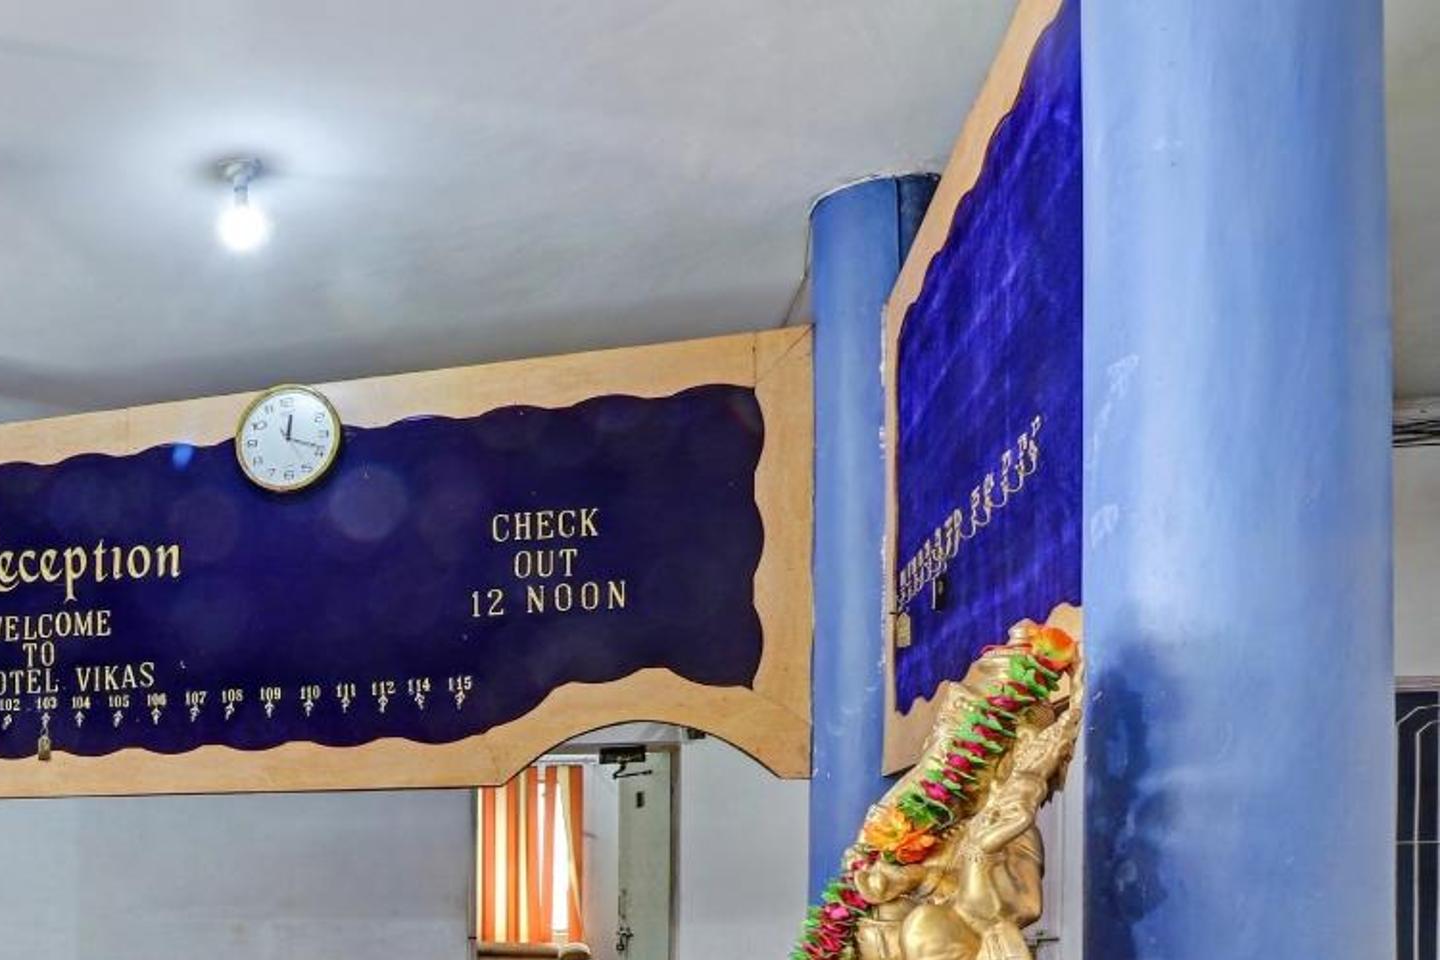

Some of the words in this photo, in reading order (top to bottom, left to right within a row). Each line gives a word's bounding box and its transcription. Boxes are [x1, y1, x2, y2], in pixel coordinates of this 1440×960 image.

[314, 413, 325, 423] 2
[491, 507, 599, 542] CHECK
[513, 547, 578, 579] OUT
[471, 588, 505, 618] 12
[526, 579, 627, 614] NOON
[22, 641, 56, 668] TO
[75, 661, 156, 693] VIKAS
[0, 698, 21, 712] 102
[72, 695, 91, 710] 104
[109, 694, 131, 708] 105
[185, 691, 207, 705] 107
[222, 688, 244, 703] 108
[260, 686, 282, 701] 109
[300, 685, 321, 699] 110
[336, 683, 356, 698] 111
[371, 680, 396, 696] 112
[408, 677, 431, 693] 114
[448, 675, 472, 691] 115
